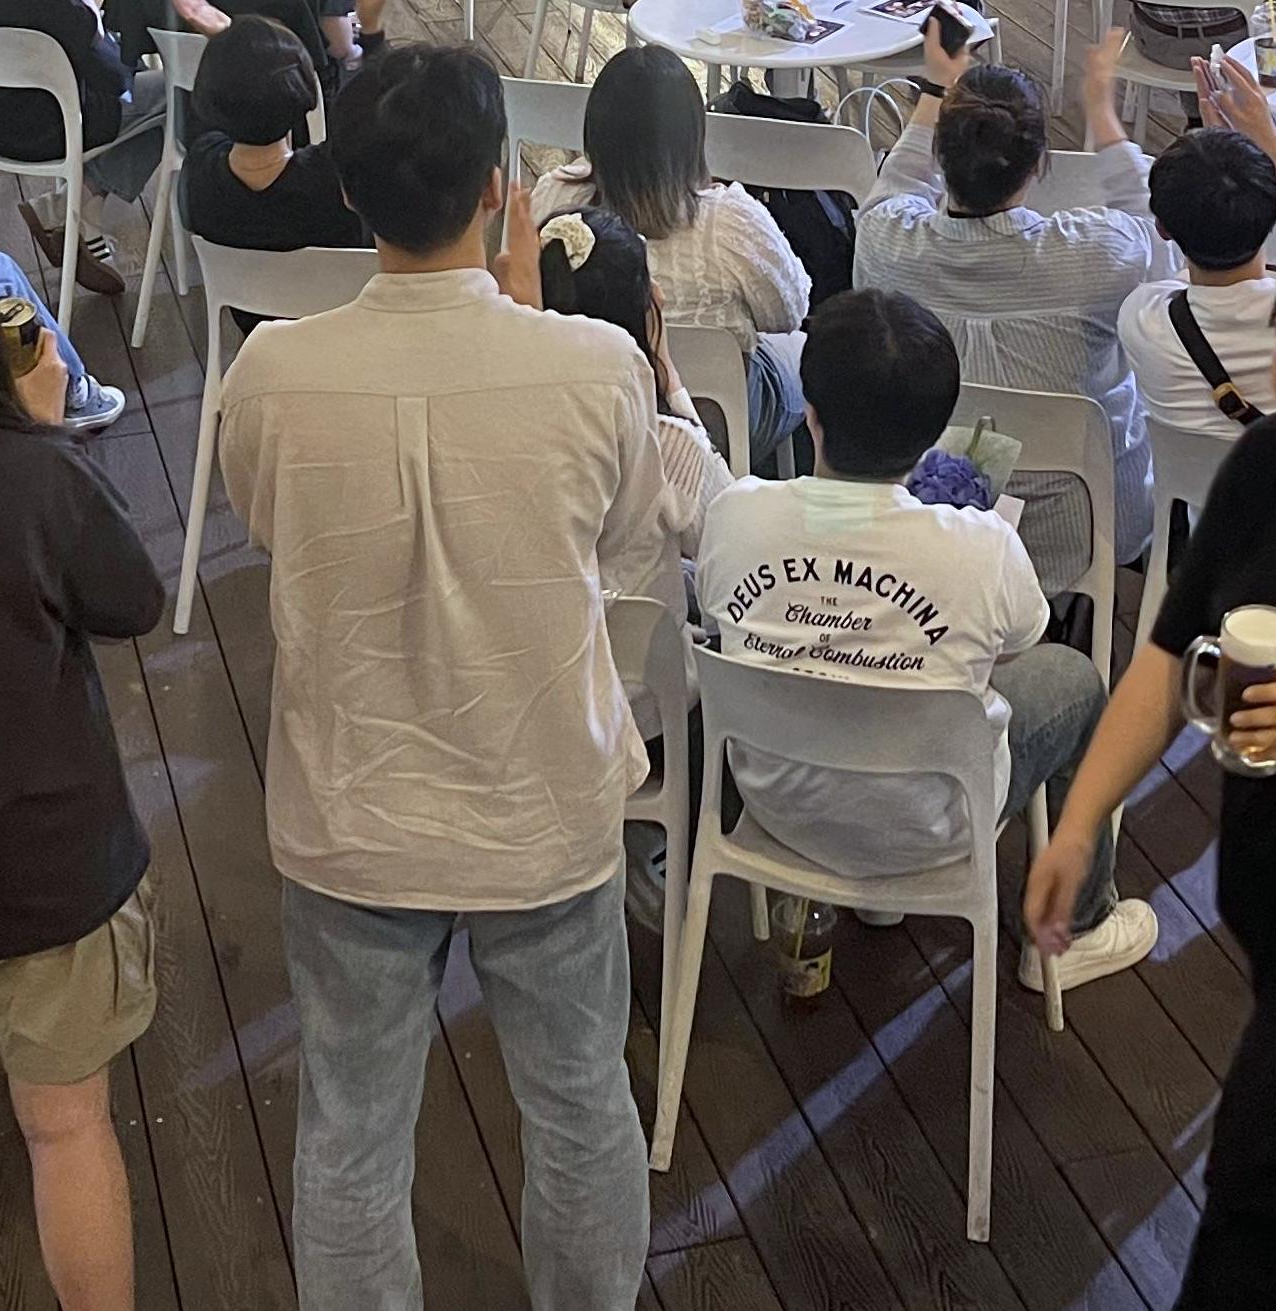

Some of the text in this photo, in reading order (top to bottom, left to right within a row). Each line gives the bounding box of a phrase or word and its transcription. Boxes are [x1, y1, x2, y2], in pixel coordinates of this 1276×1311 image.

[726, 557, 949, 646] DEUS EX MACHINA
[820, 596, 838, 607] THE
[785, 602, 872, 632] Chamber
[819, 633, 832, 643] OF
[809, 644, 925, 671] Combustion
